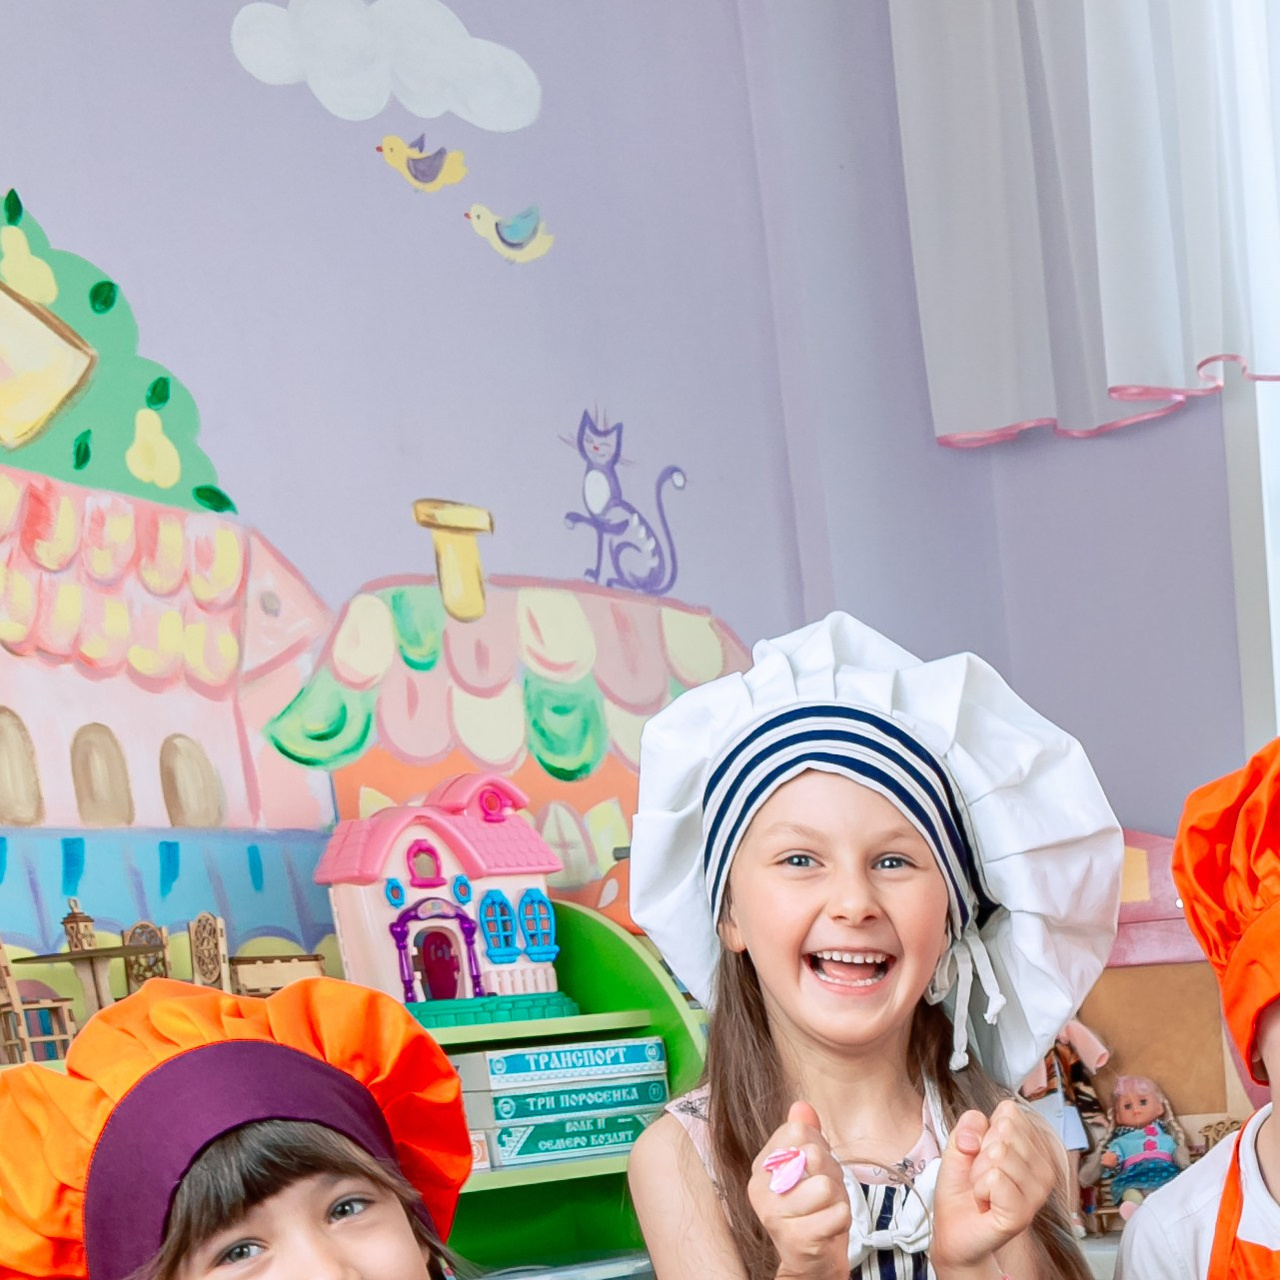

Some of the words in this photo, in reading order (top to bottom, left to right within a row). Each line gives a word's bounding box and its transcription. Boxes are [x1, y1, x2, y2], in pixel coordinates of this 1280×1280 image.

[525, 1047, 626, 1071] ТРАНСПОРТ
[527, 1096, 555, 1111] ТРИ
[560, 1087, 639, 1108] ПОРОСЕНКА
[538, 1136, 588, 1151] СЕМЕРО
[590, 1130, 634, 1145] КОЗЛЯТ
